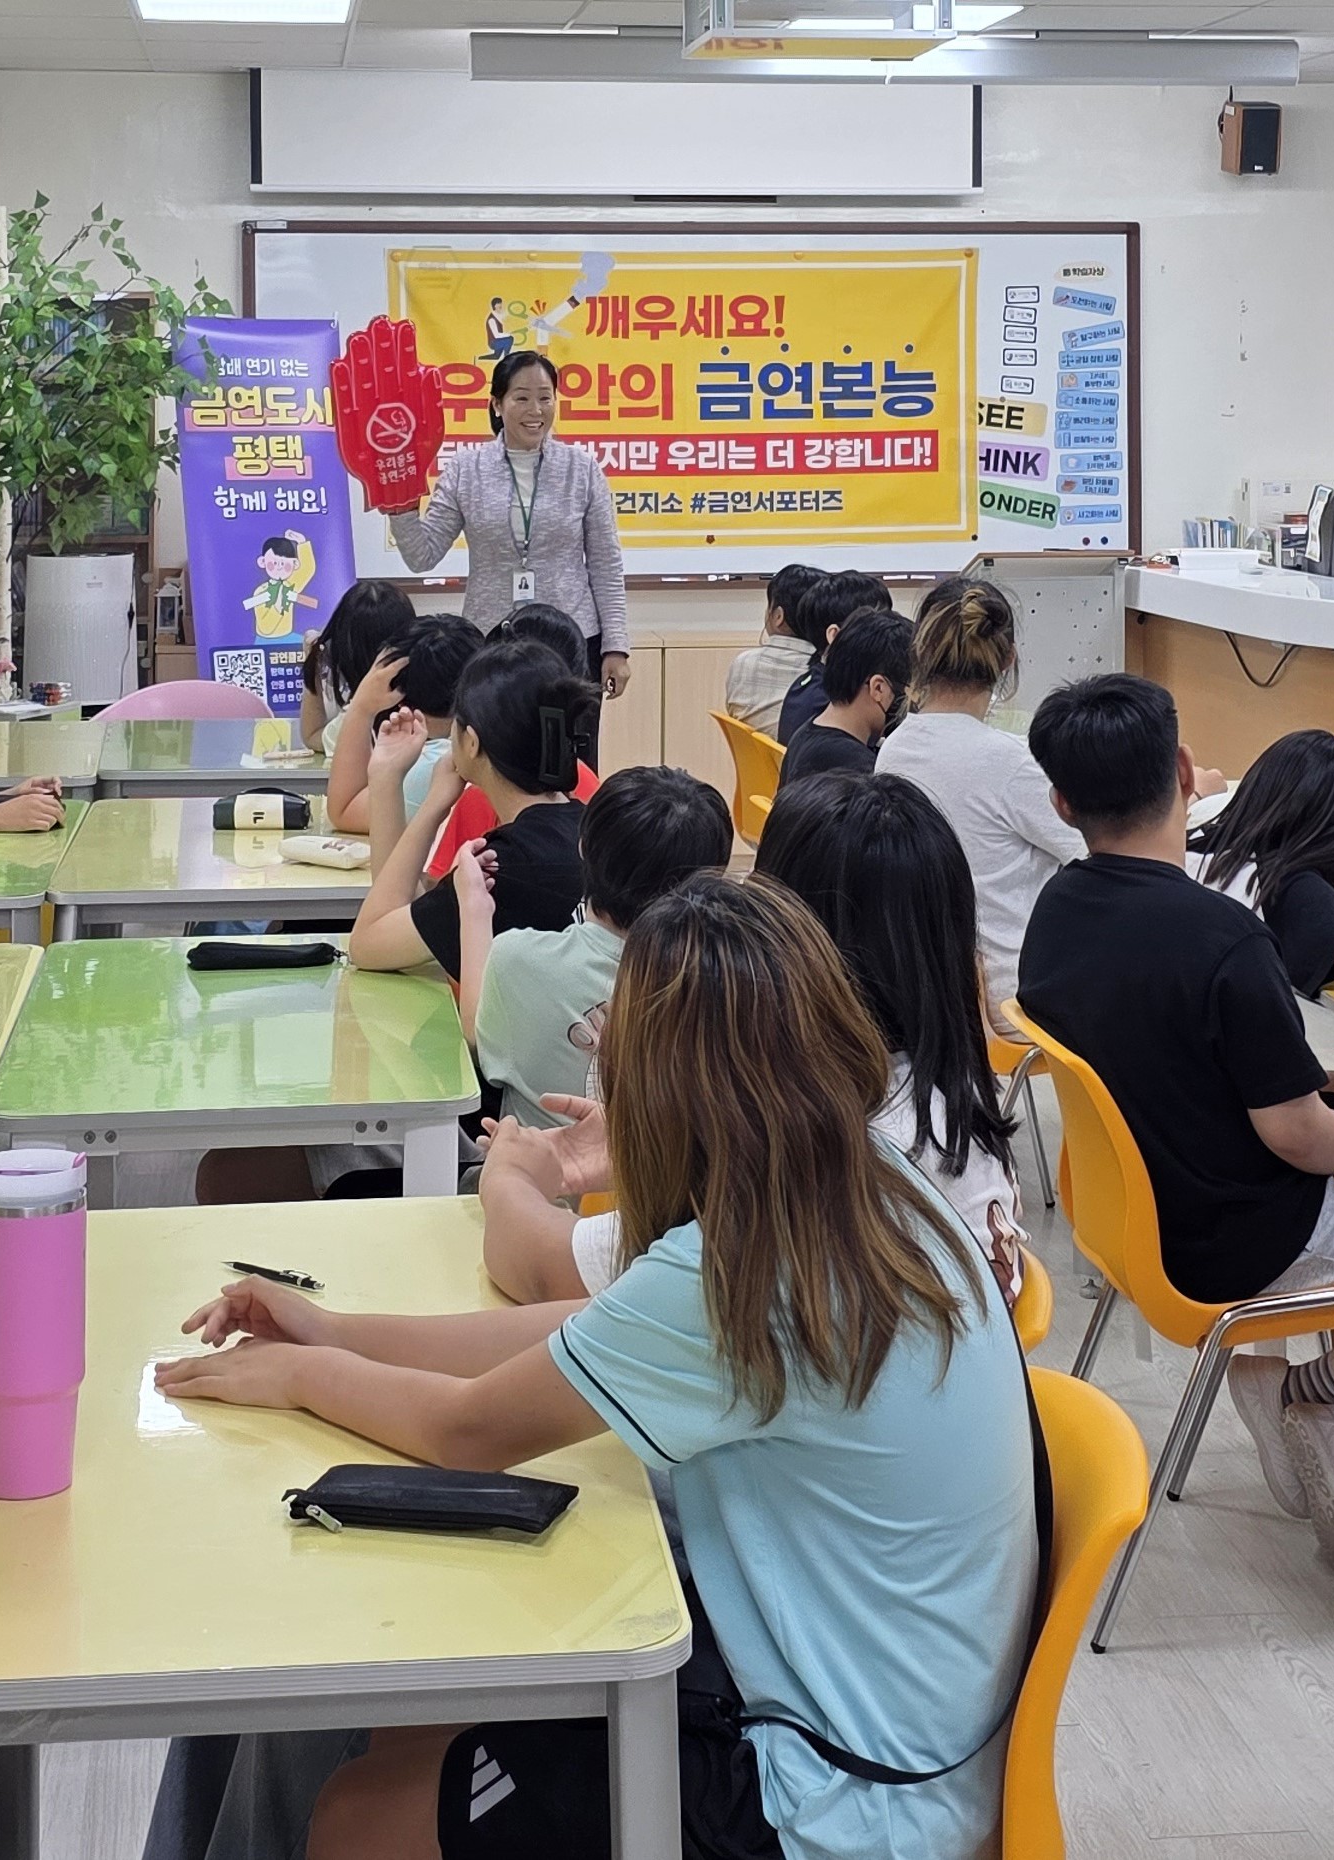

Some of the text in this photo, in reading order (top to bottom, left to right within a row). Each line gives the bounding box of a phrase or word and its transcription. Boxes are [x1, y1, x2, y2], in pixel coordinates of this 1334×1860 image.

[586, 294, 786, 340] 깨우세요!
[246, 357, 277, 377] 연기
[279, 357, 310, 378] 없는
[190, 386, 334, 427] 금연도시
[557, 363, 674, 421] 안의
[696, 361, 937, 420] 금연본능
[232, 435, 306, 475] 평택
[667, 440, 756, 470] 우리는
[766, 440, 794, 469] 더
[804, 437, 932, 469] 강합니다!
[214, 485, 329, 518] 함께 해요!
[610, 489, 844, 515] 건지소 #금연서포터즈
